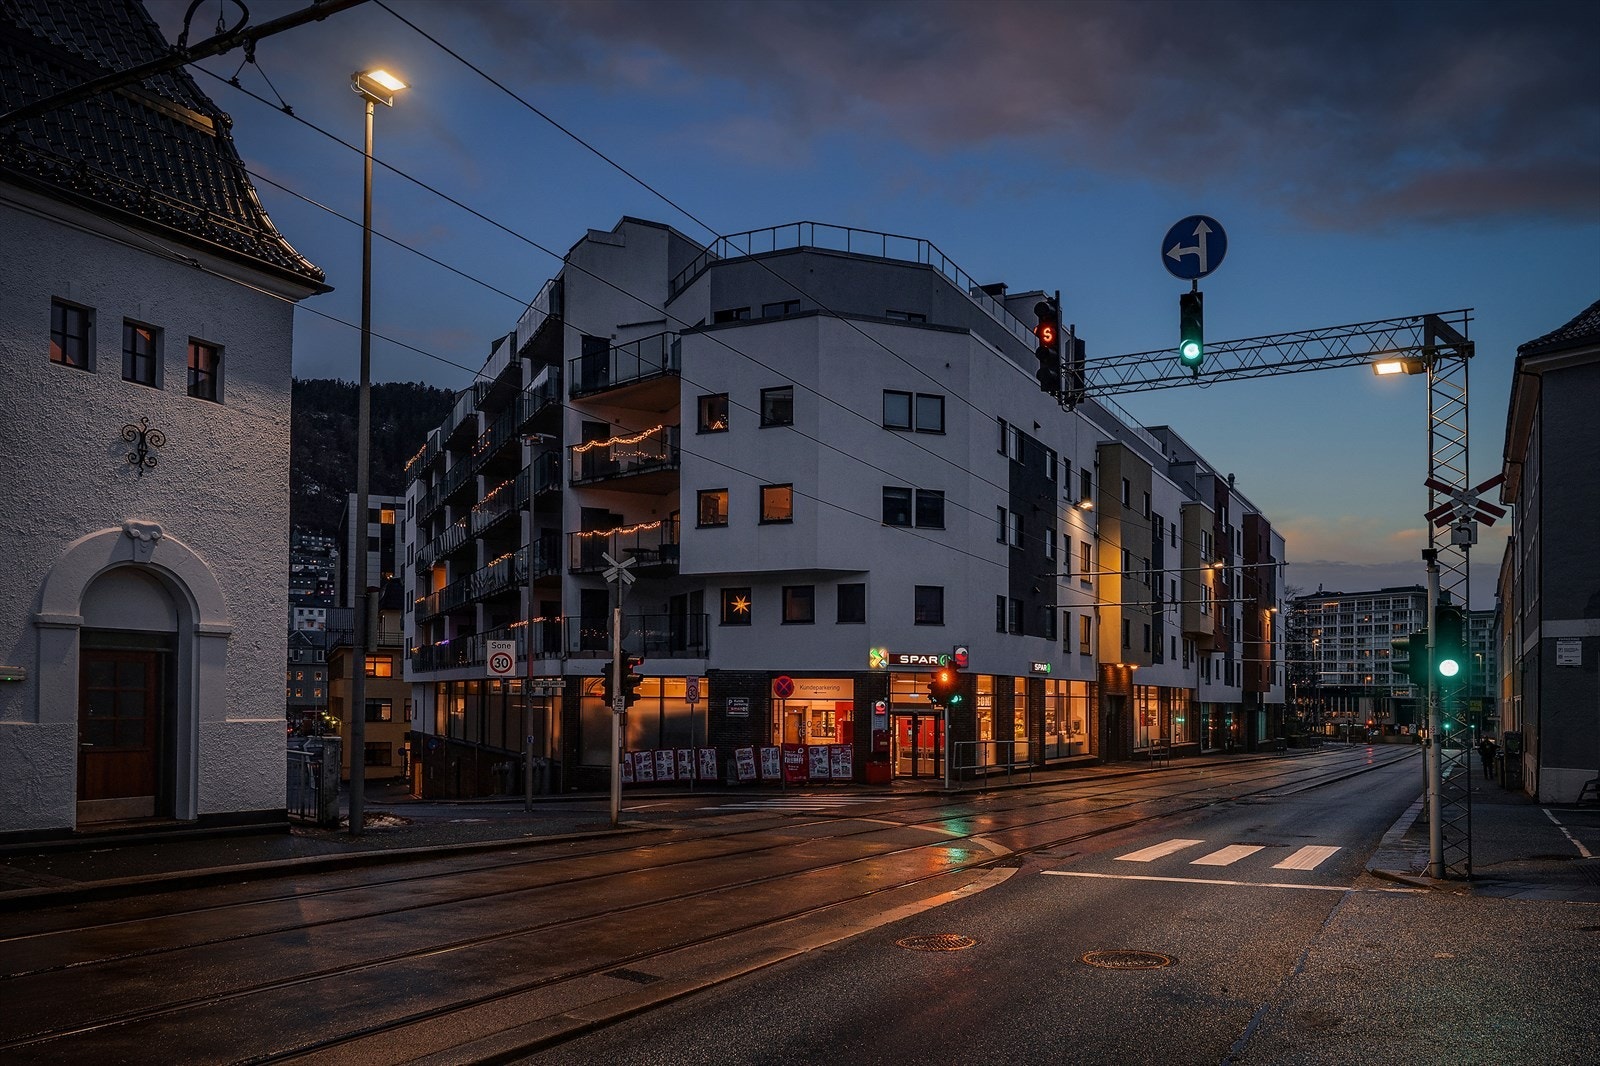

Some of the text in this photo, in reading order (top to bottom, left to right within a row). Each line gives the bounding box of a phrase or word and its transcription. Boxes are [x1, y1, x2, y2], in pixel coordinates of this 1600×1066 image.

[1043, 327, 1052, 342] S
[491, 641, 512, 650] Sone
[494, 658, 509, 669] 30
[900, 655, 938, 664] SPAR
[1034, 663, 1047, 672] SPAR
[940, 673, 948, 682] S
